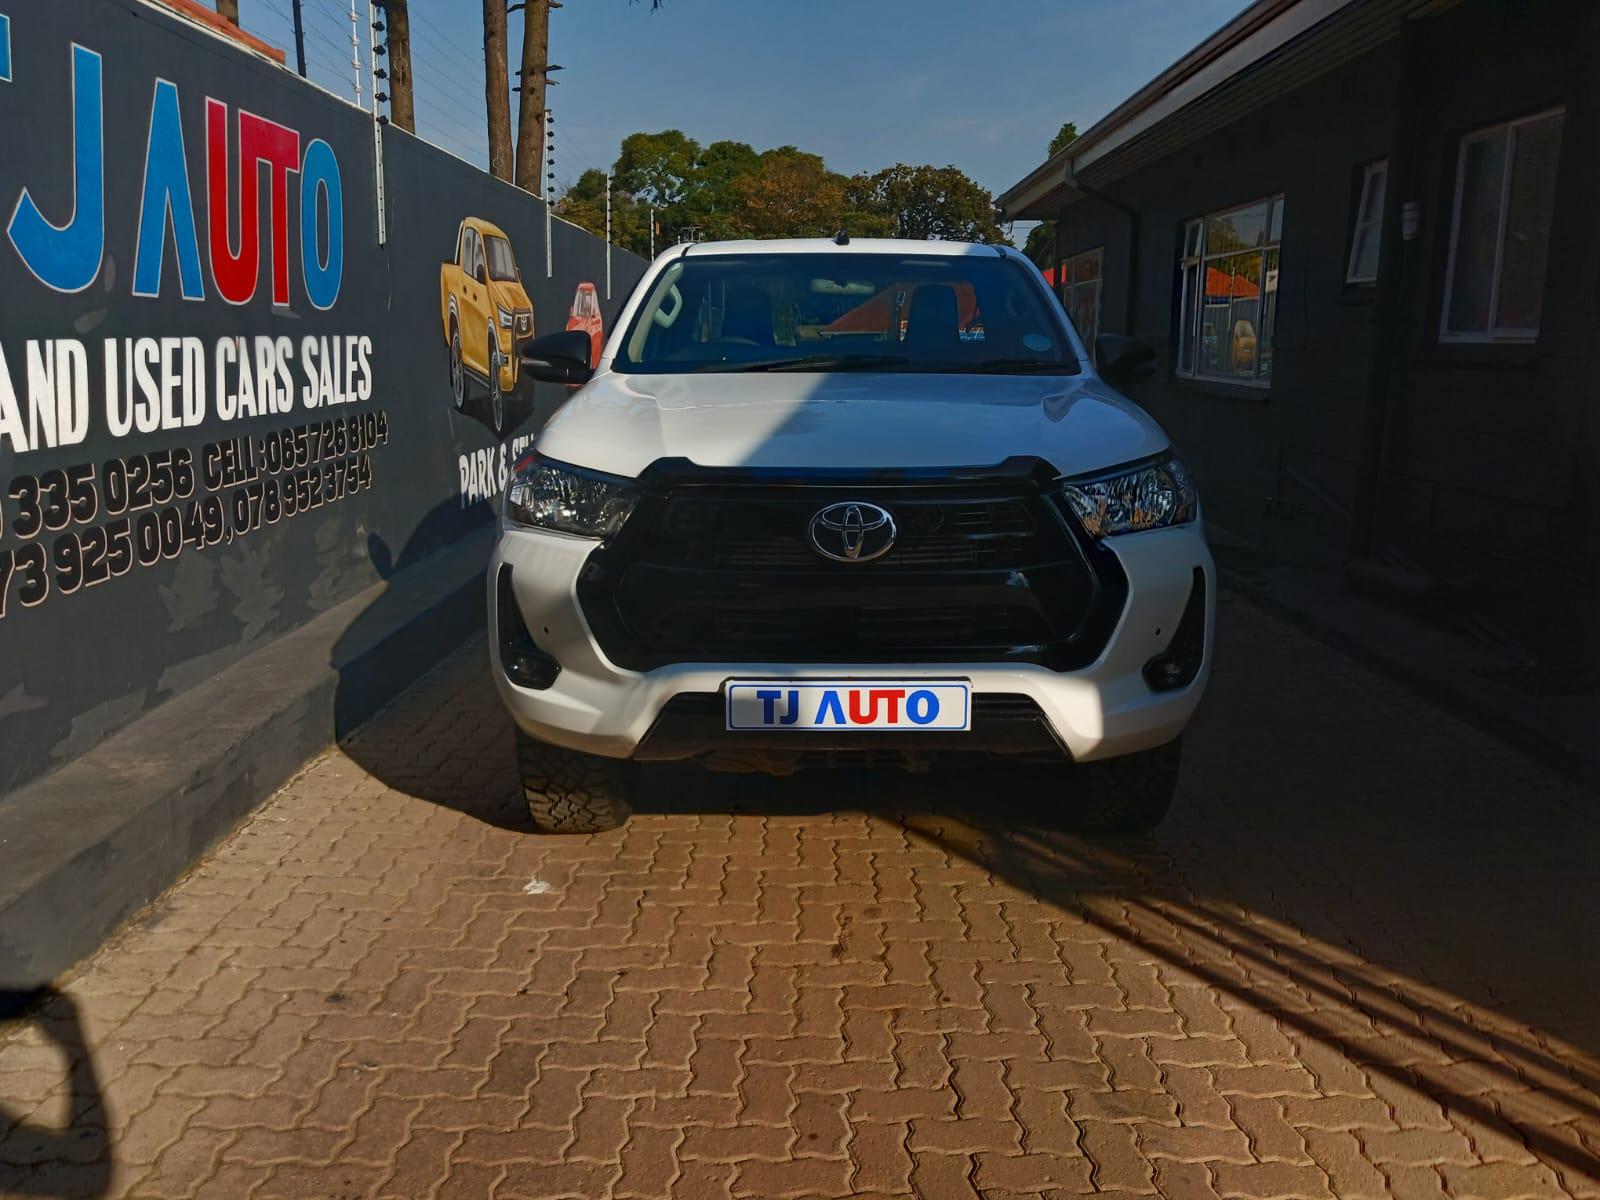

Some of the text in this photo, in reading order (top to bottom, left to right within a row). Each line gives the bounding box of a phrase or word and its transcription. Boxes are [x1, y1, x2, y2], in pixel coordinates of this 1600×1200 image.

[0, 13, 343, 310] J AUTO
[104, 336, 206, 437] USED
[216, 335, 294, 421] CARS
[301, 335, 373, 408] SALES
[9, 464, 98, 540] 335
[102, 448, 195, 515] 0256
[458, 446, 497, 509] PARK
[498, 442, 508, 492] &
[53, 517, 133, 595] 925
[756, 690, 940, 725] TJ AUTO
